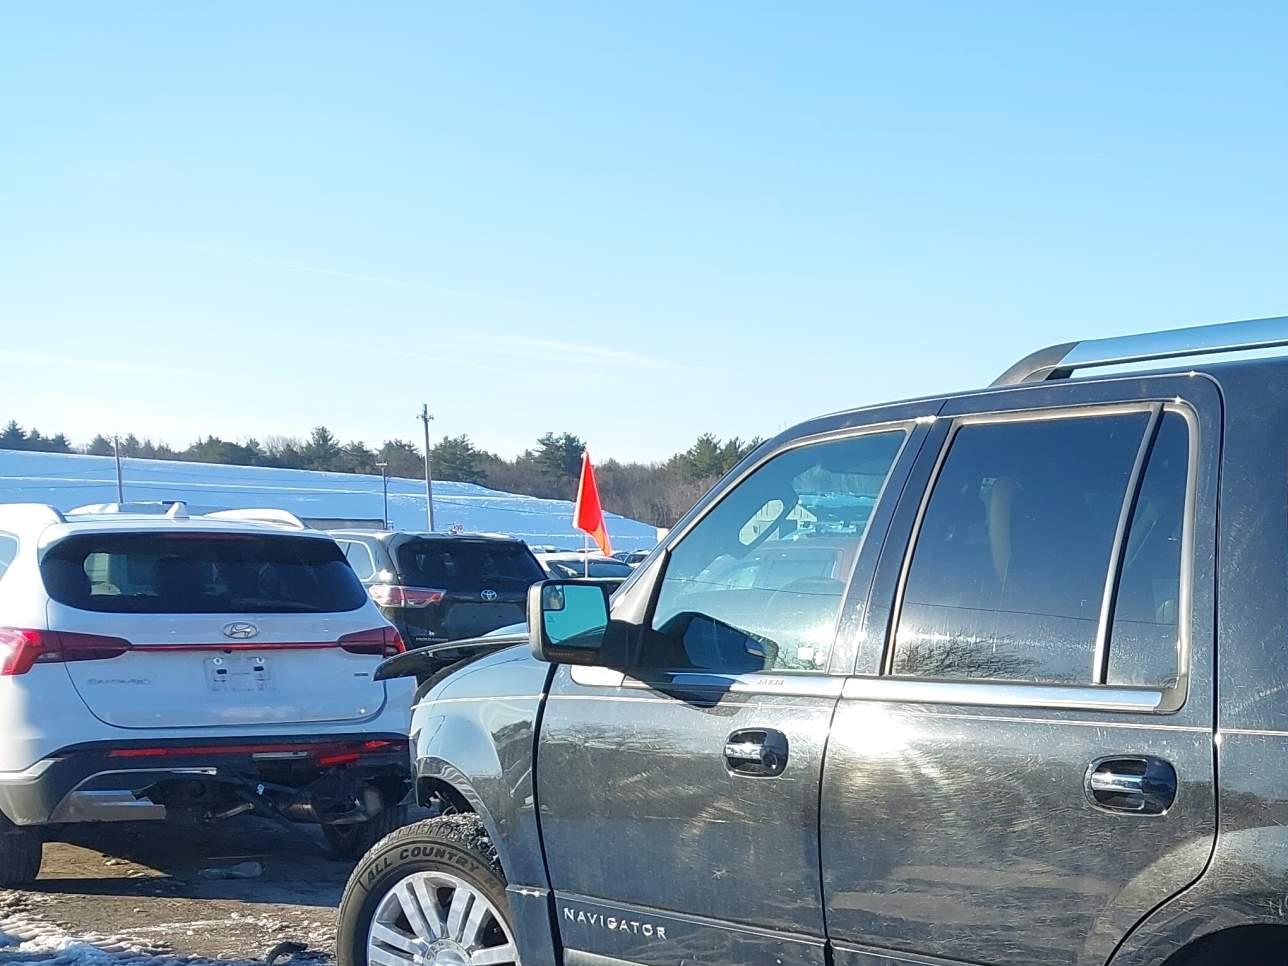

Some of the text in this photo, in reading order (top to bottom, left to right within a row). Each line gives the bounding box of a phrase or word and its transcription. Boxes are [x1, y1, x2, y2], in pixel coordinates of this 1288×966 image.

[367, 846, 480, 883] ALL COUNTRY
[563, 907, 667, 940] NAVIGATOR
